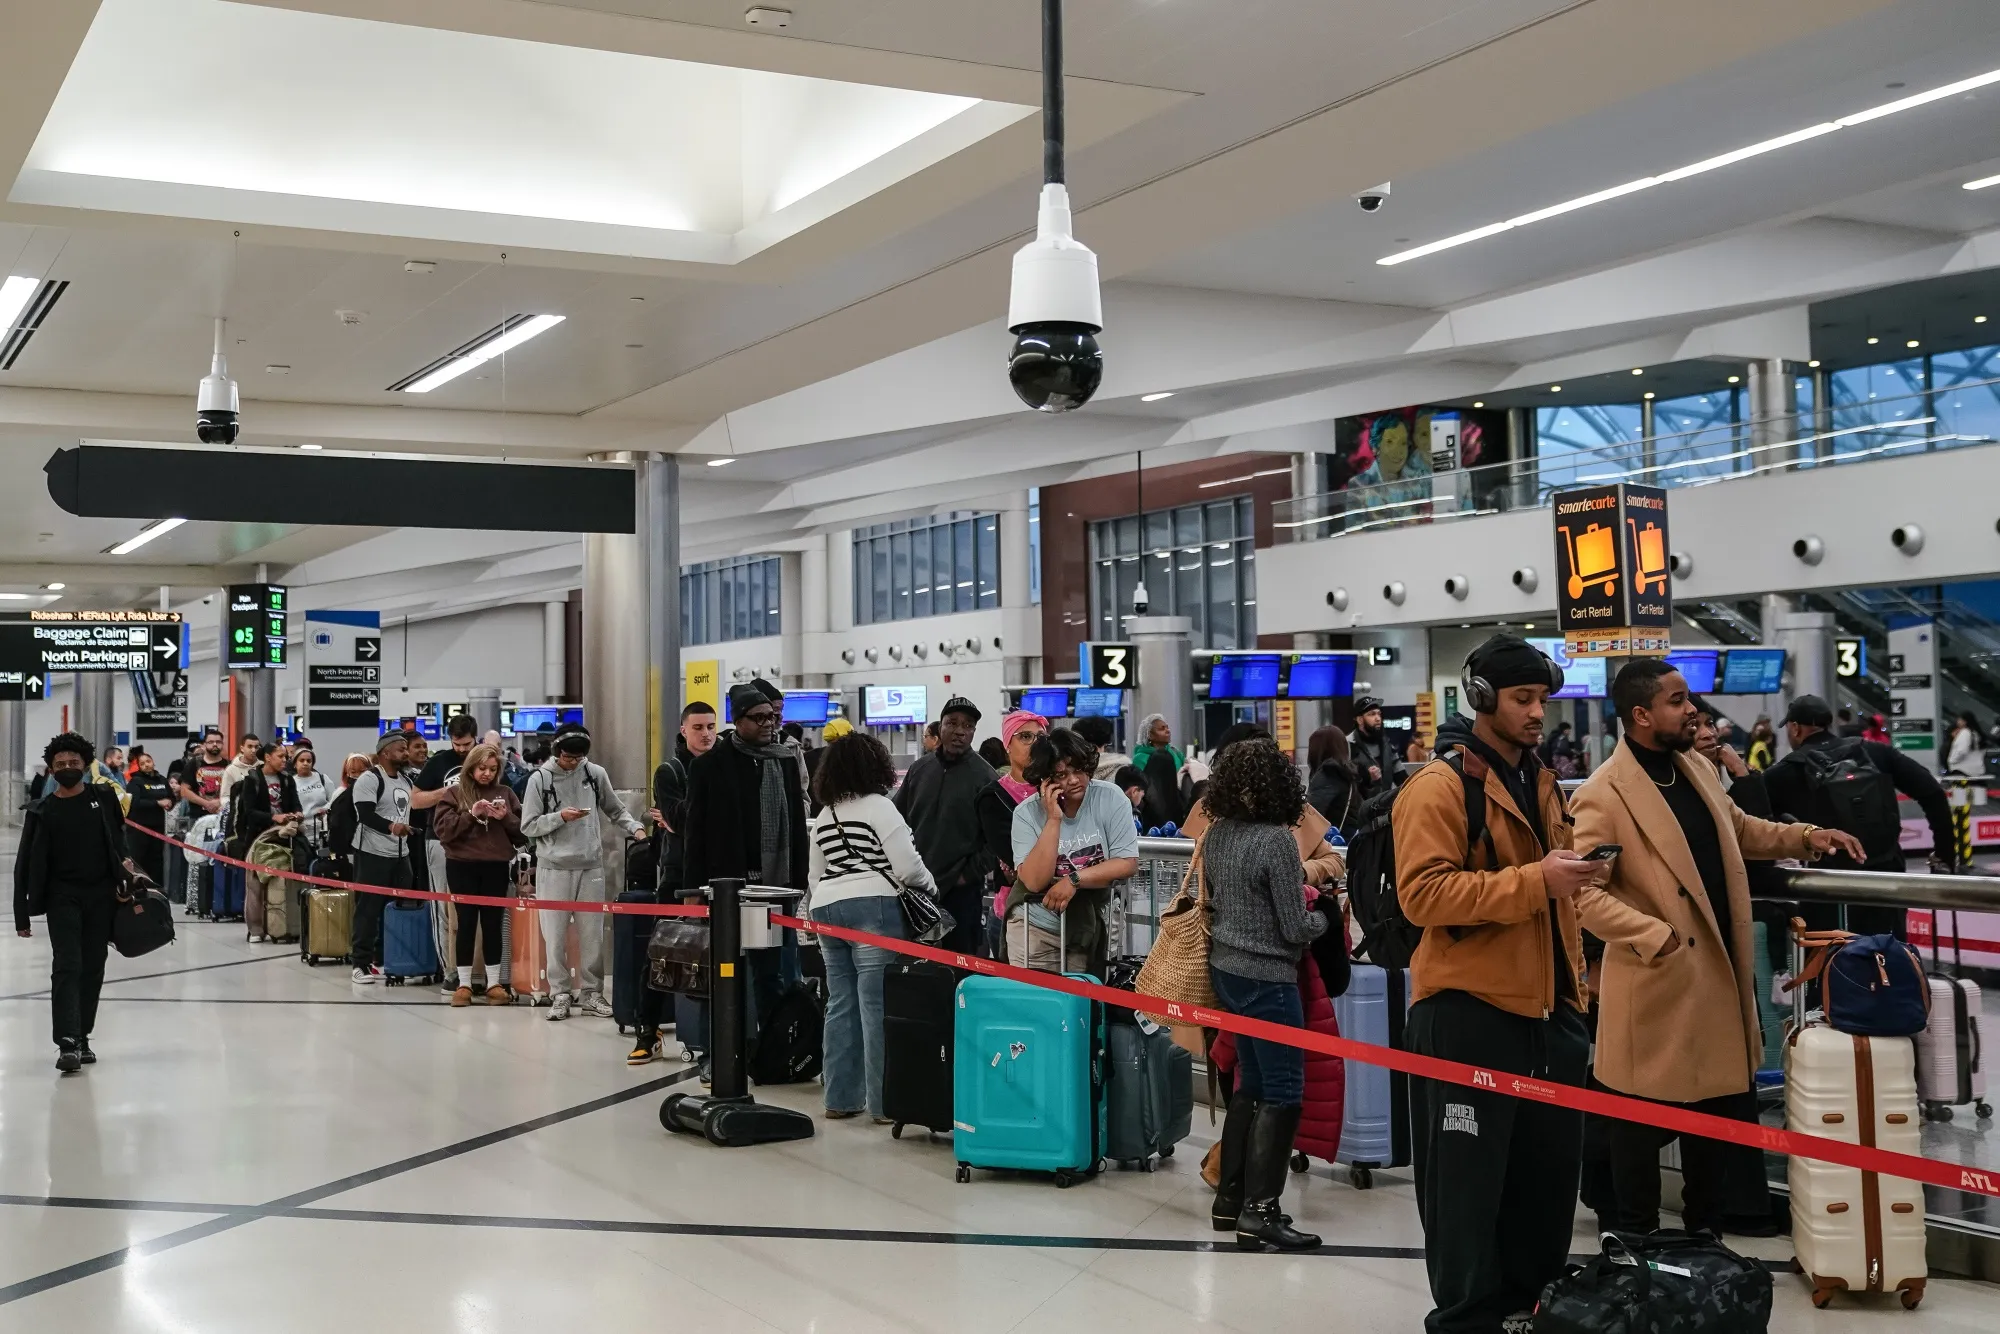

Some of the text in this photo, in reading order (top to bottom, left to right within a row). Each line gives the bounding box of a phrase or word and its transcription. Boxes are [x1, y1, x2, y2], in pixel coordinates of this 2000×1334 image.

[1557, 494, 1616, 515] smartecarte
[1626, 494, 1664, 511] smartecarte
[30, 610, 73, 621] Rideshare
[148, 611, 168, 620] Uber
[1570, 605, 1613, 619] Cart Rental
[1637, 603, 1665, 616] Cart Rental
[33, 627, 128, 640] Baggage Claim
[97, 639, 128, 647] Equipaje
[41, 650, 79, 662] North
[80, 650, 128, 663] Parking
[1837, 641, 1858, 677] 3
[317, 668, 337, 676] North
[338, 668, 363, 676] Parking
[1101, 648, 1127, 686] 3
[693, 672, 710, 686] spirit
[330, 692, 363, 700] Rideshare
[803, 920, 812, 930] ATL
[956, 955, 969, 967] ATL
[1167, 1003, 1183, 1018] ATL
[1472, 1070, 1497, 1088] ATL
[1445, 1103, 1475, 1121] UNDER
[1443, 1117, 1479, 1137] ARMOUR
[1961, 1170, 1999, 1192] ATL
